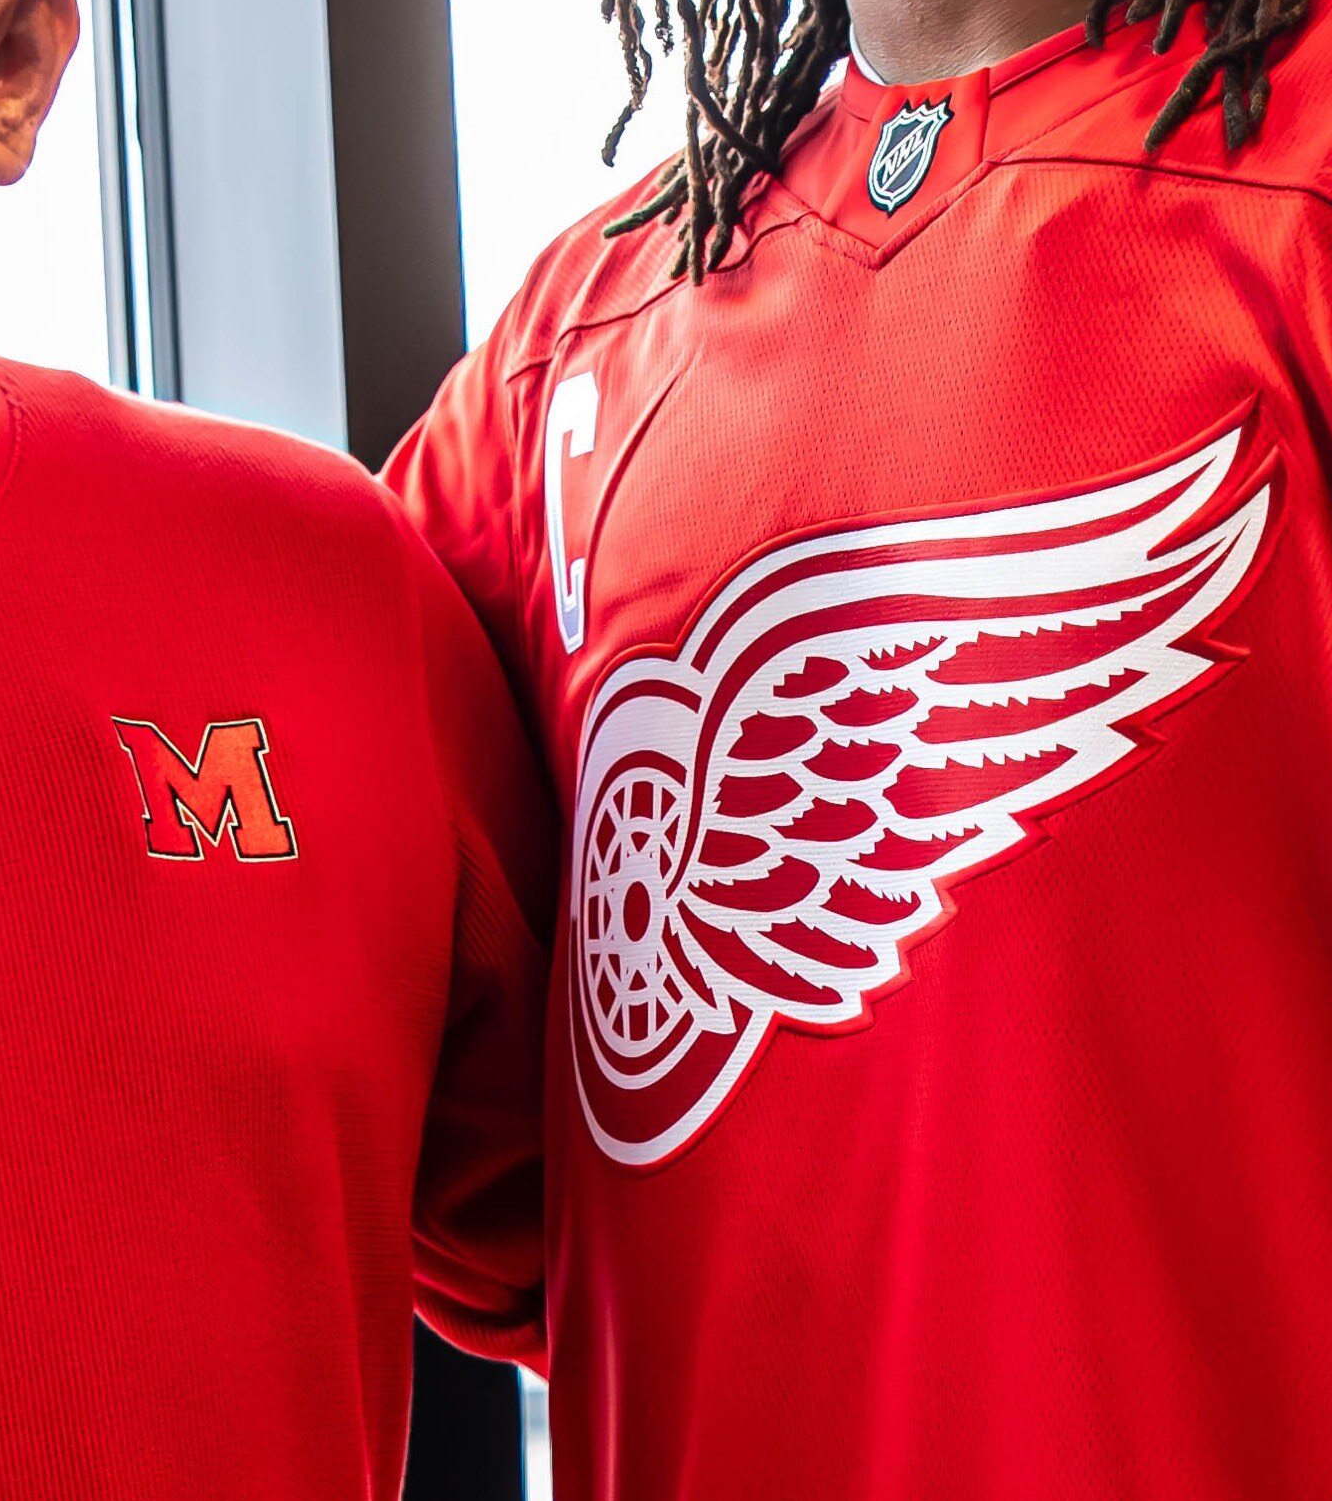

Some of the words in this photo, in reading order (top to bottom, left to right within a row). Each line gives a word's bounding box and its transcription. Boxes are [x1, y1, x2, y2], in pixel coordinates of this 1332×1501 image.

[881, 127, 925, 185] NHL
[544, 371, 600, 656] C
[110, 715, 299, 863] M
